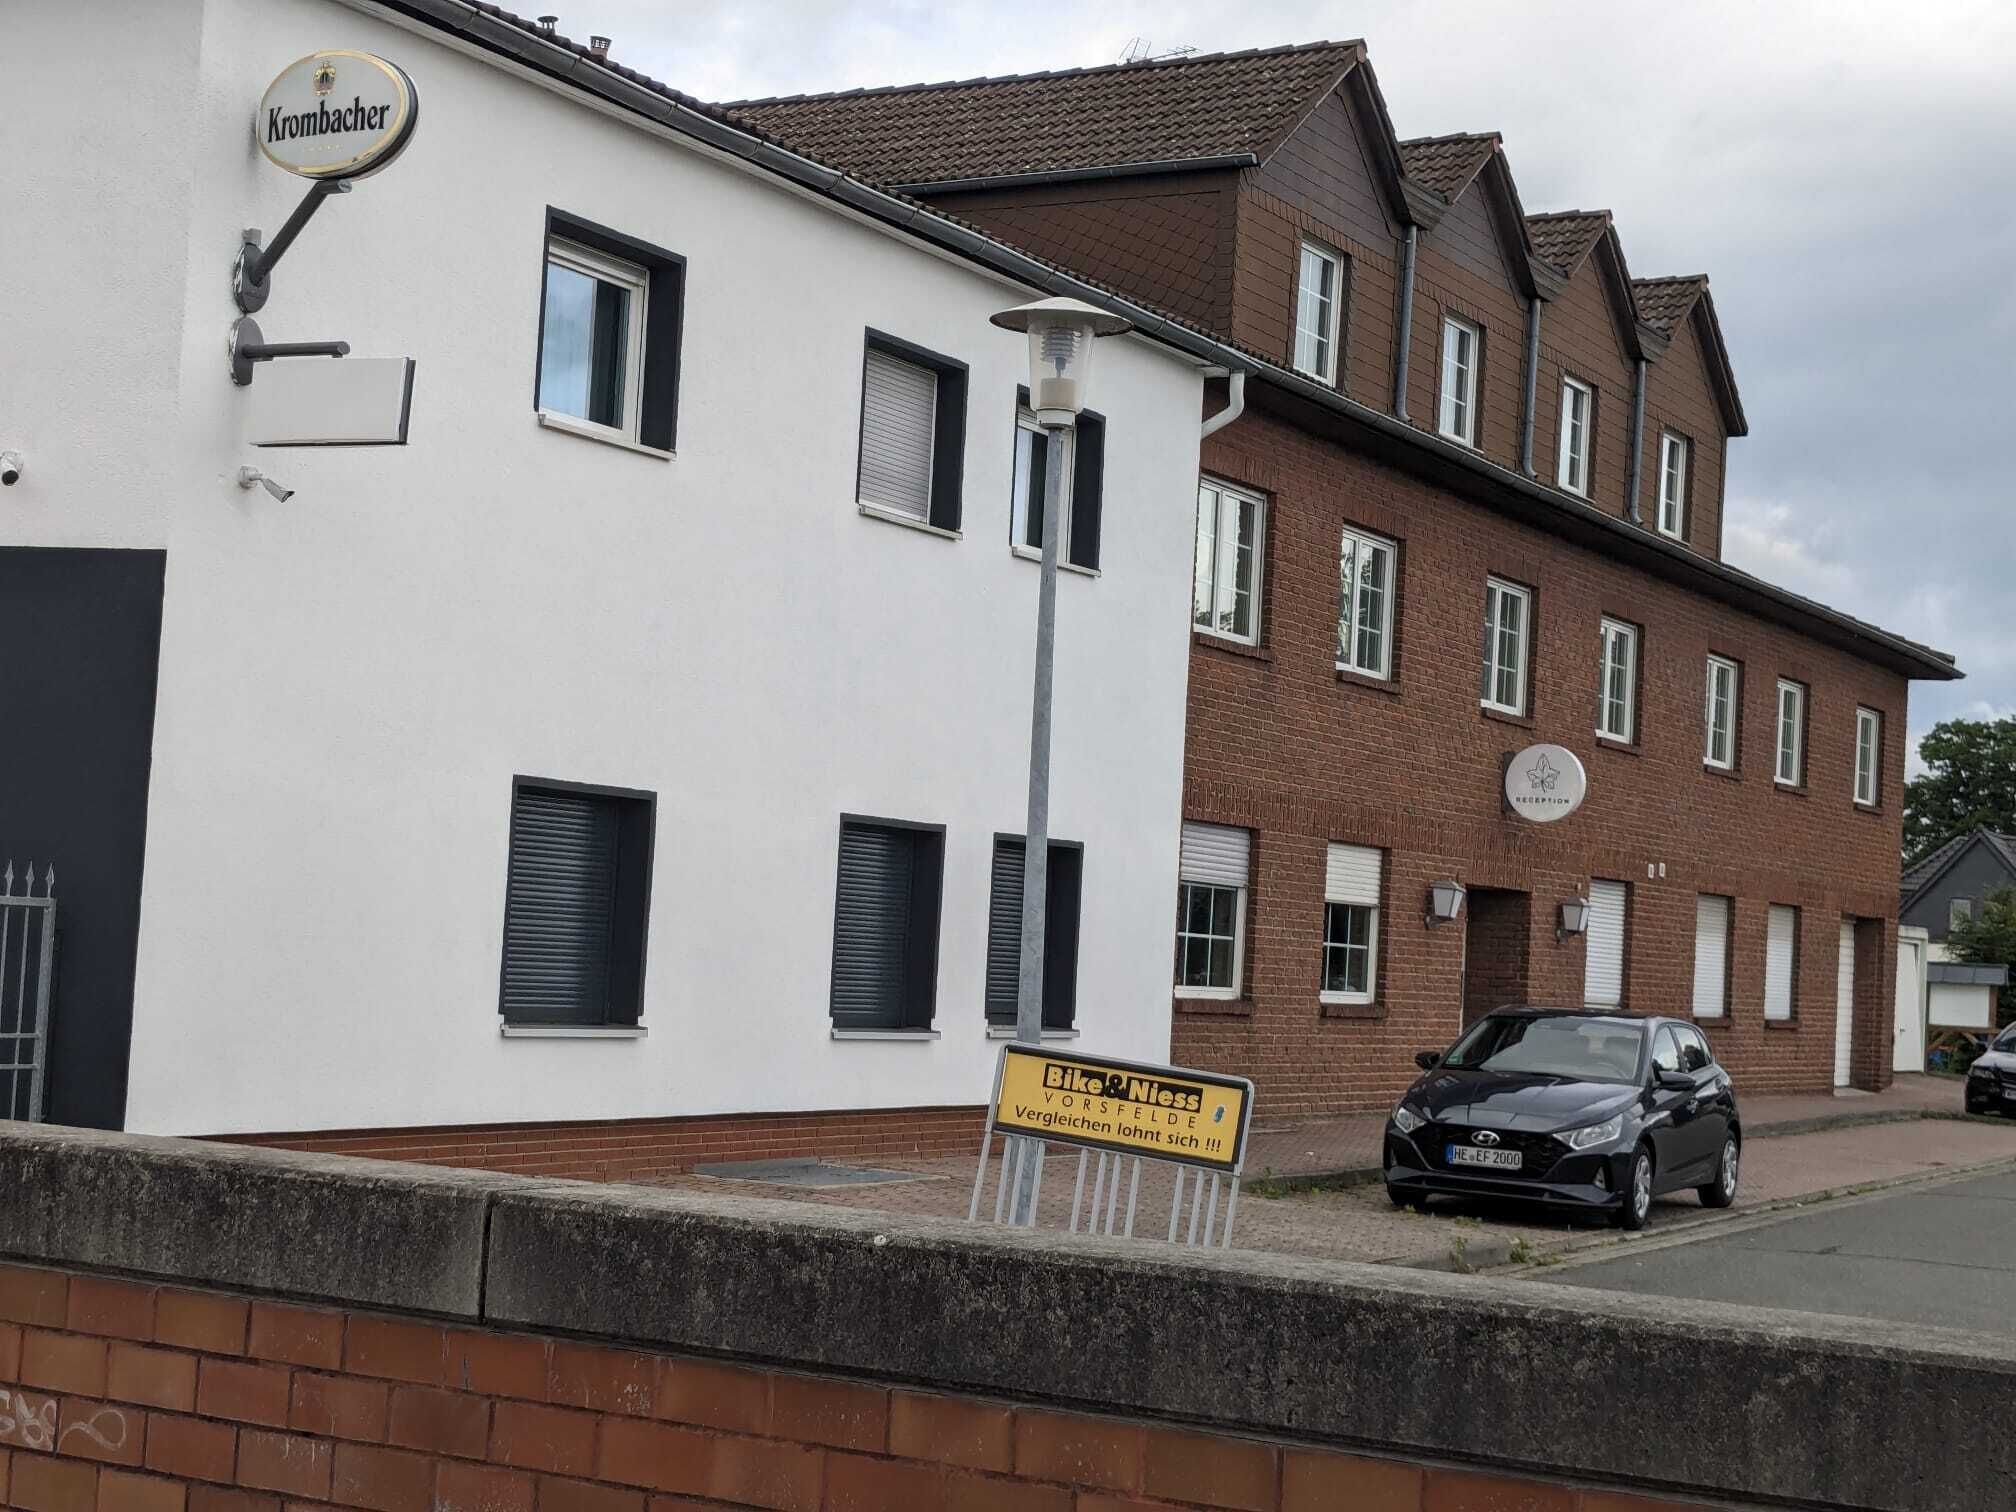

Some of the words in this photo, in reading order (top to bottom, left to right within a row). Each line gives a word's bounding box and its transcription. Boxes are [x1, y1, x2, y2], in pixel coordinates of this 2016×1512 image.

[267, 96, 390, 143] Krombacher
[1515, 796, 1569, 804] RECEPTION
[1015, 1105, 1111, 1134] Vergleichen
[1117, 1122, 1161, 1144] lohnt
[1166, 1133, 1199, 1149] sich
[1044, 1092, 1198, 1128] VORSFELDE
[1454, 1147, 1467, 1161] HE
[1476, 1150, 1489, 1162] EF
[1493, 1151, 1520, 1166] 2000
